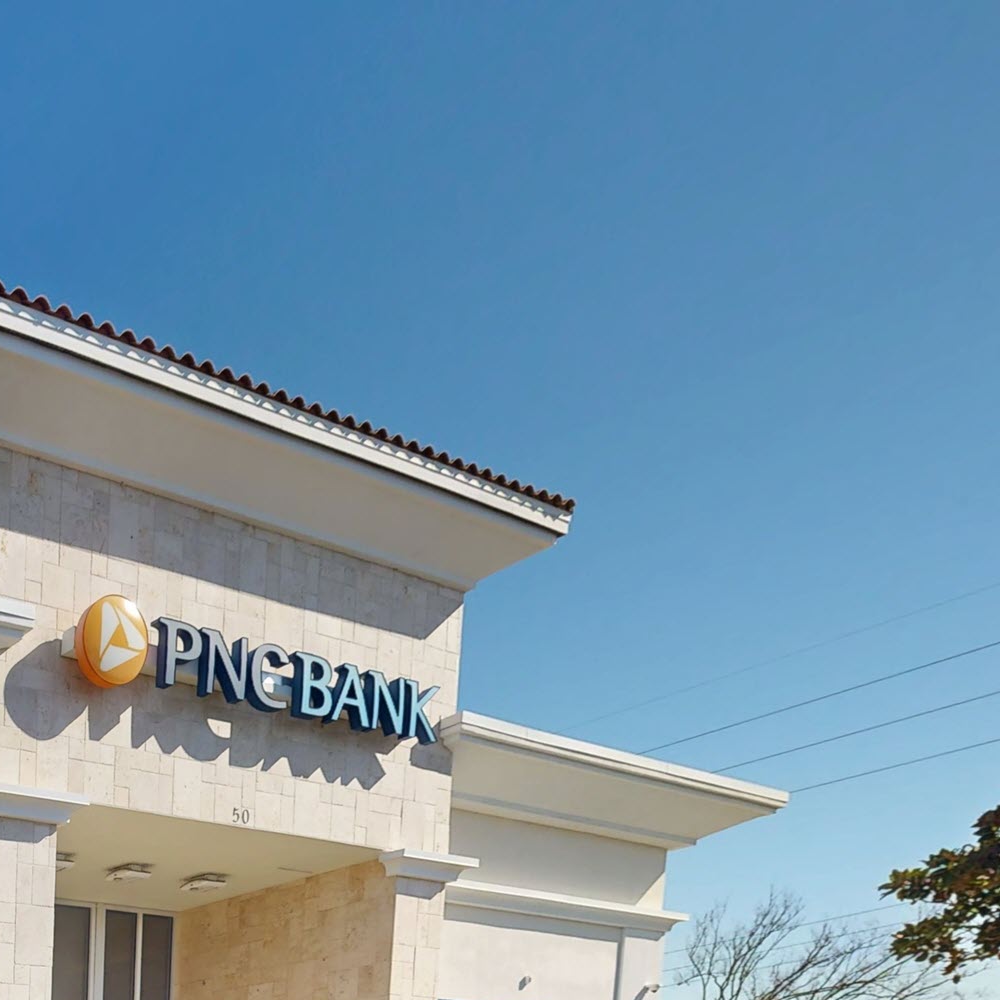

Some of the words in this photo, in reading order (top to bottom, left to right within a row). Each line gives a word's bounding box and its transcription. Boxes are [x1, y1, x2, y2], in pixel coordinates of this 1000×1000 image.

[151, 617, 290, 712] PNC
[291, 650, 440, 746] BANK
[232, 807, 250, 825] 50
